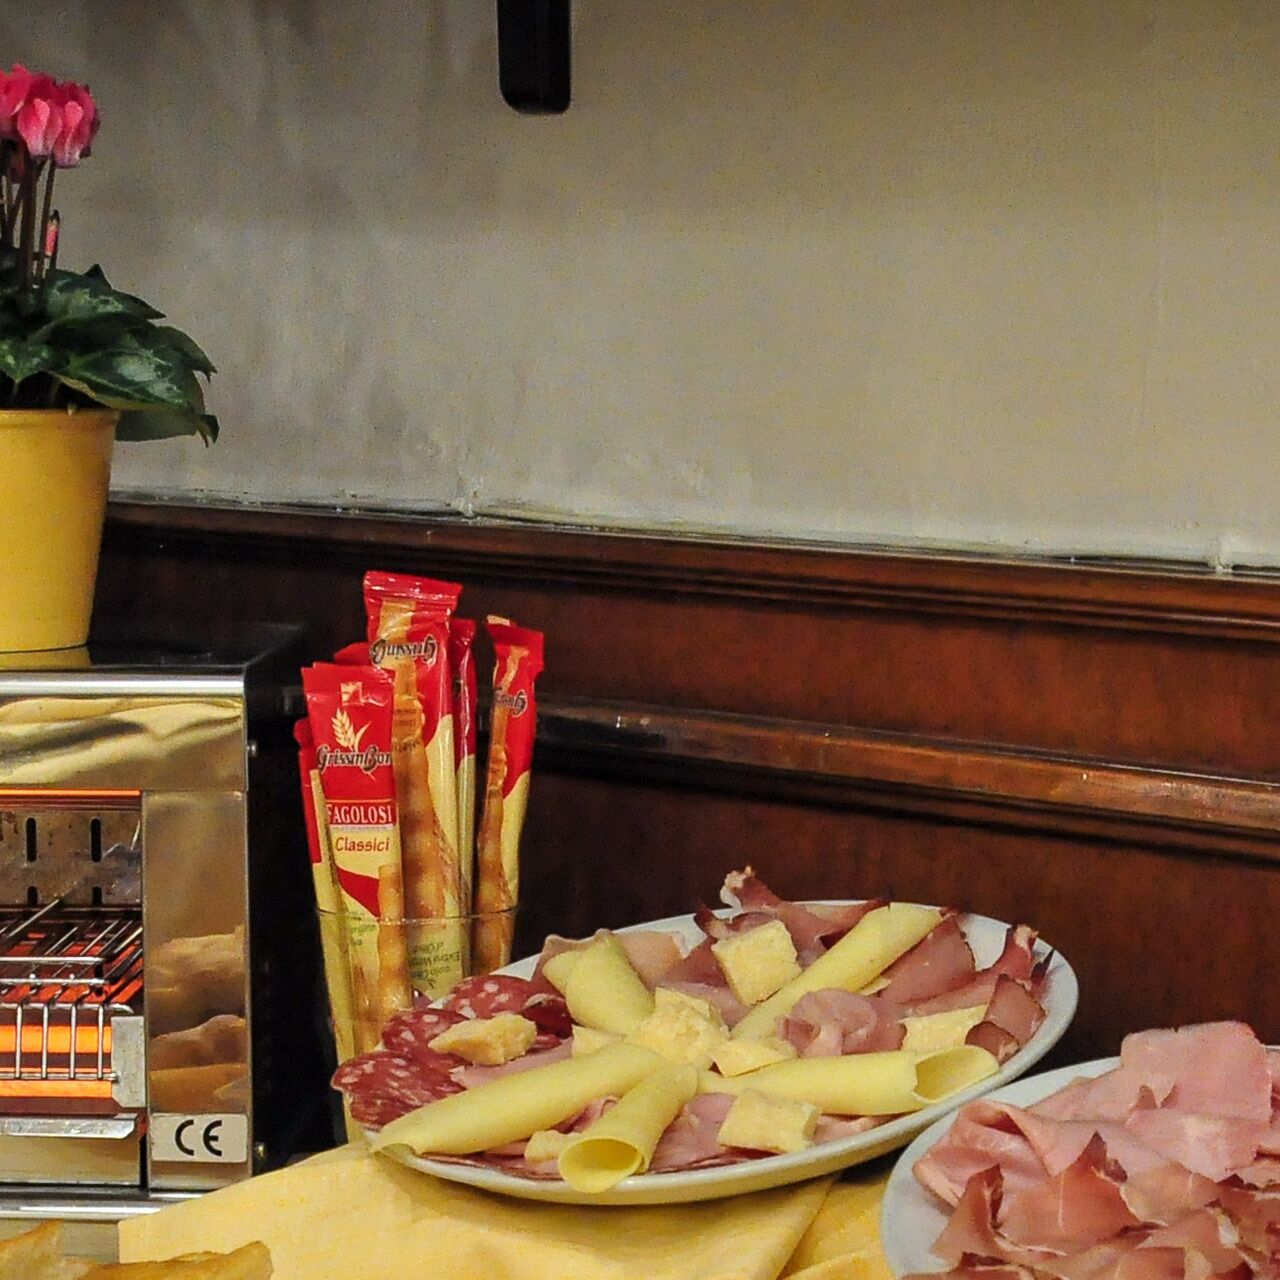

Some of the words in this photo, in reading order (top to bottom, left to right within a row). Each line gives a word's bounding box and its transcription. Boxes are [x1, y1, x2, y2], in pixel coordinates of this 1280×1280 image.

[317, 744, 393, 775] GrissinBon
[335, 837, 390, 852] Classici
[175, 1119, 222, 1157] CE
